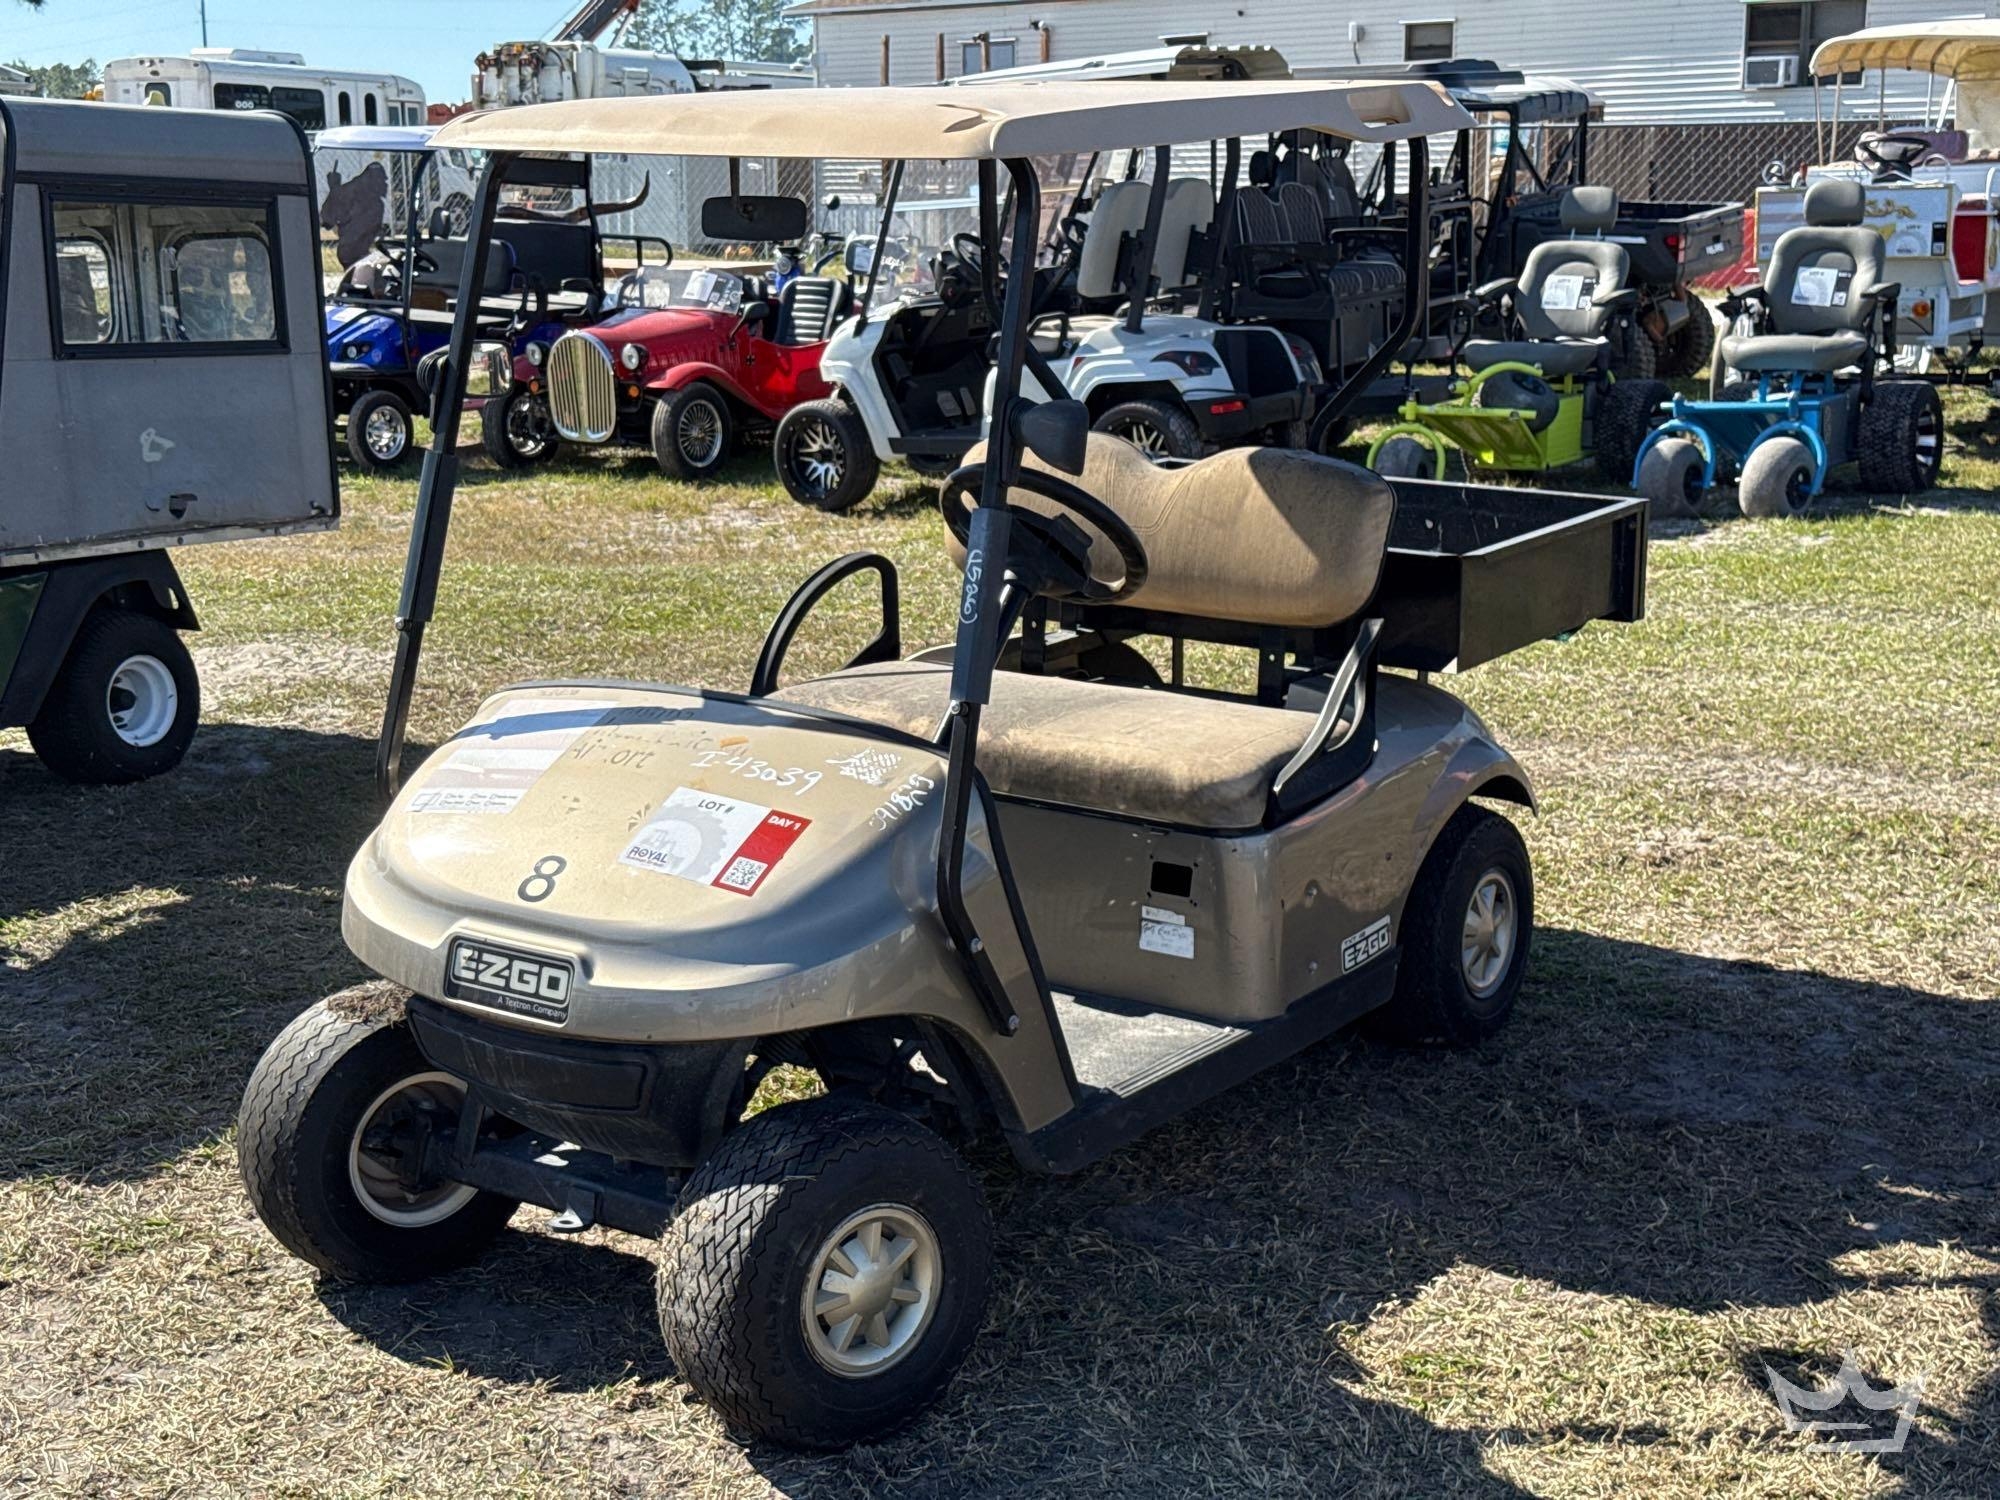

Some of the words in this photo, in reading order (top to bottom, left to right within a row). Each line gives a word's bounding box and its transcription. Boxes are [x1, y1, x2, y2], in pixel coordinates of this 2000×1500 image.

[698, 800, 725, 812] LOT
[767, 815, 794, 828] DAY
[792, 822, 802, 831] 1
[629, 846, 667, 863] ROYAL
[518, 855, 567, 902] 8
[498, 996, 503, 1004] A
[505, 997, 531, 1010] Textron
[533, 1004, 567, 1020] Company
